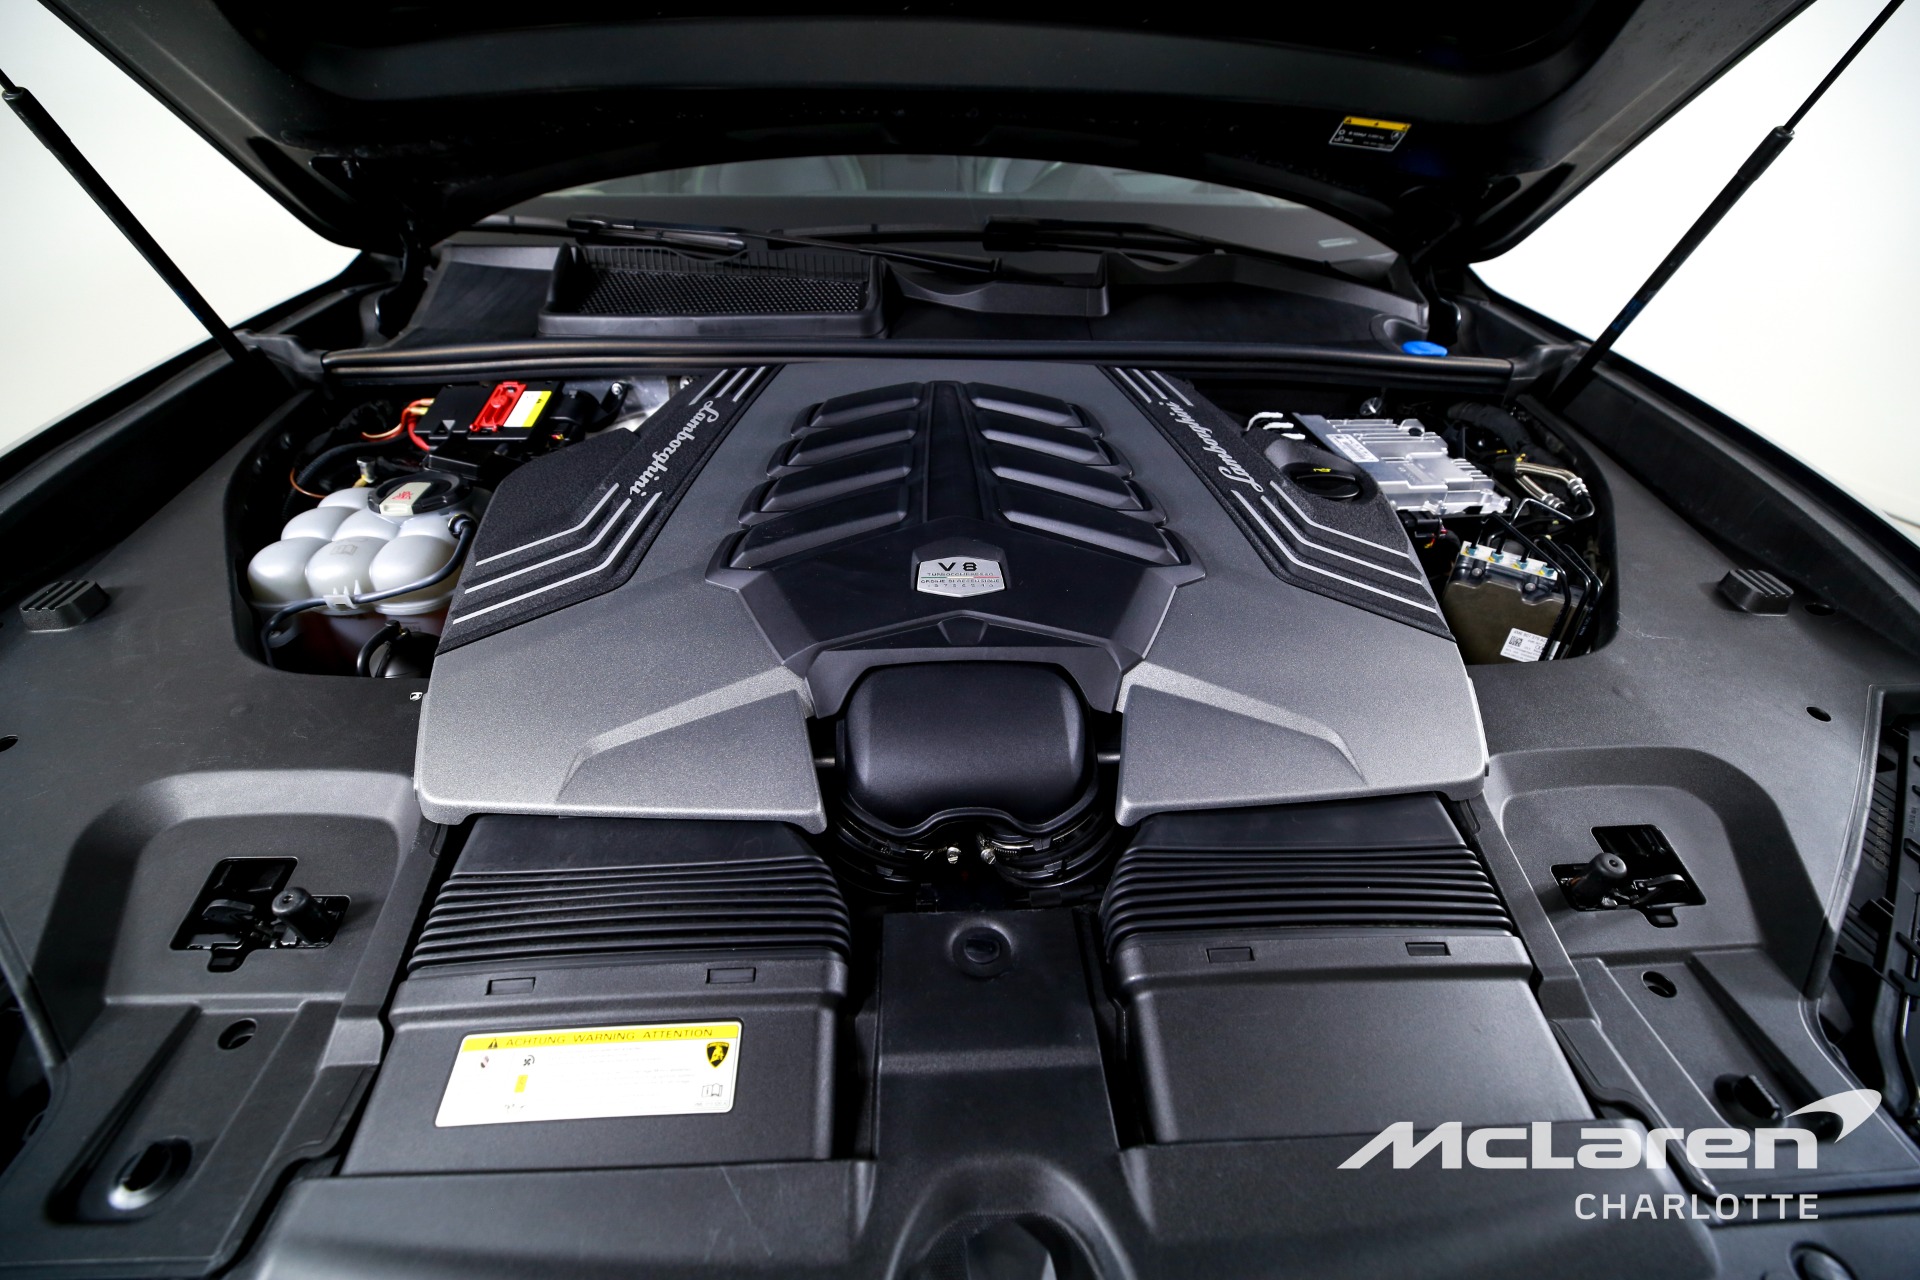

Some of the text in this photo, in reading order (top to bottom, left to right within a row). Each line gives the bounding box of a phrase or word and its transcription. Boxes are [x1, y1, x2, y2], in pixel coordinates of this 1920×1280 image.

[629, 400, 720, 497] Lamborghini
[1158, 401, 1264, 492] Lamborghini
[505, 1028, 713, 1047] ACHTUNG WARNING ATTENTION
